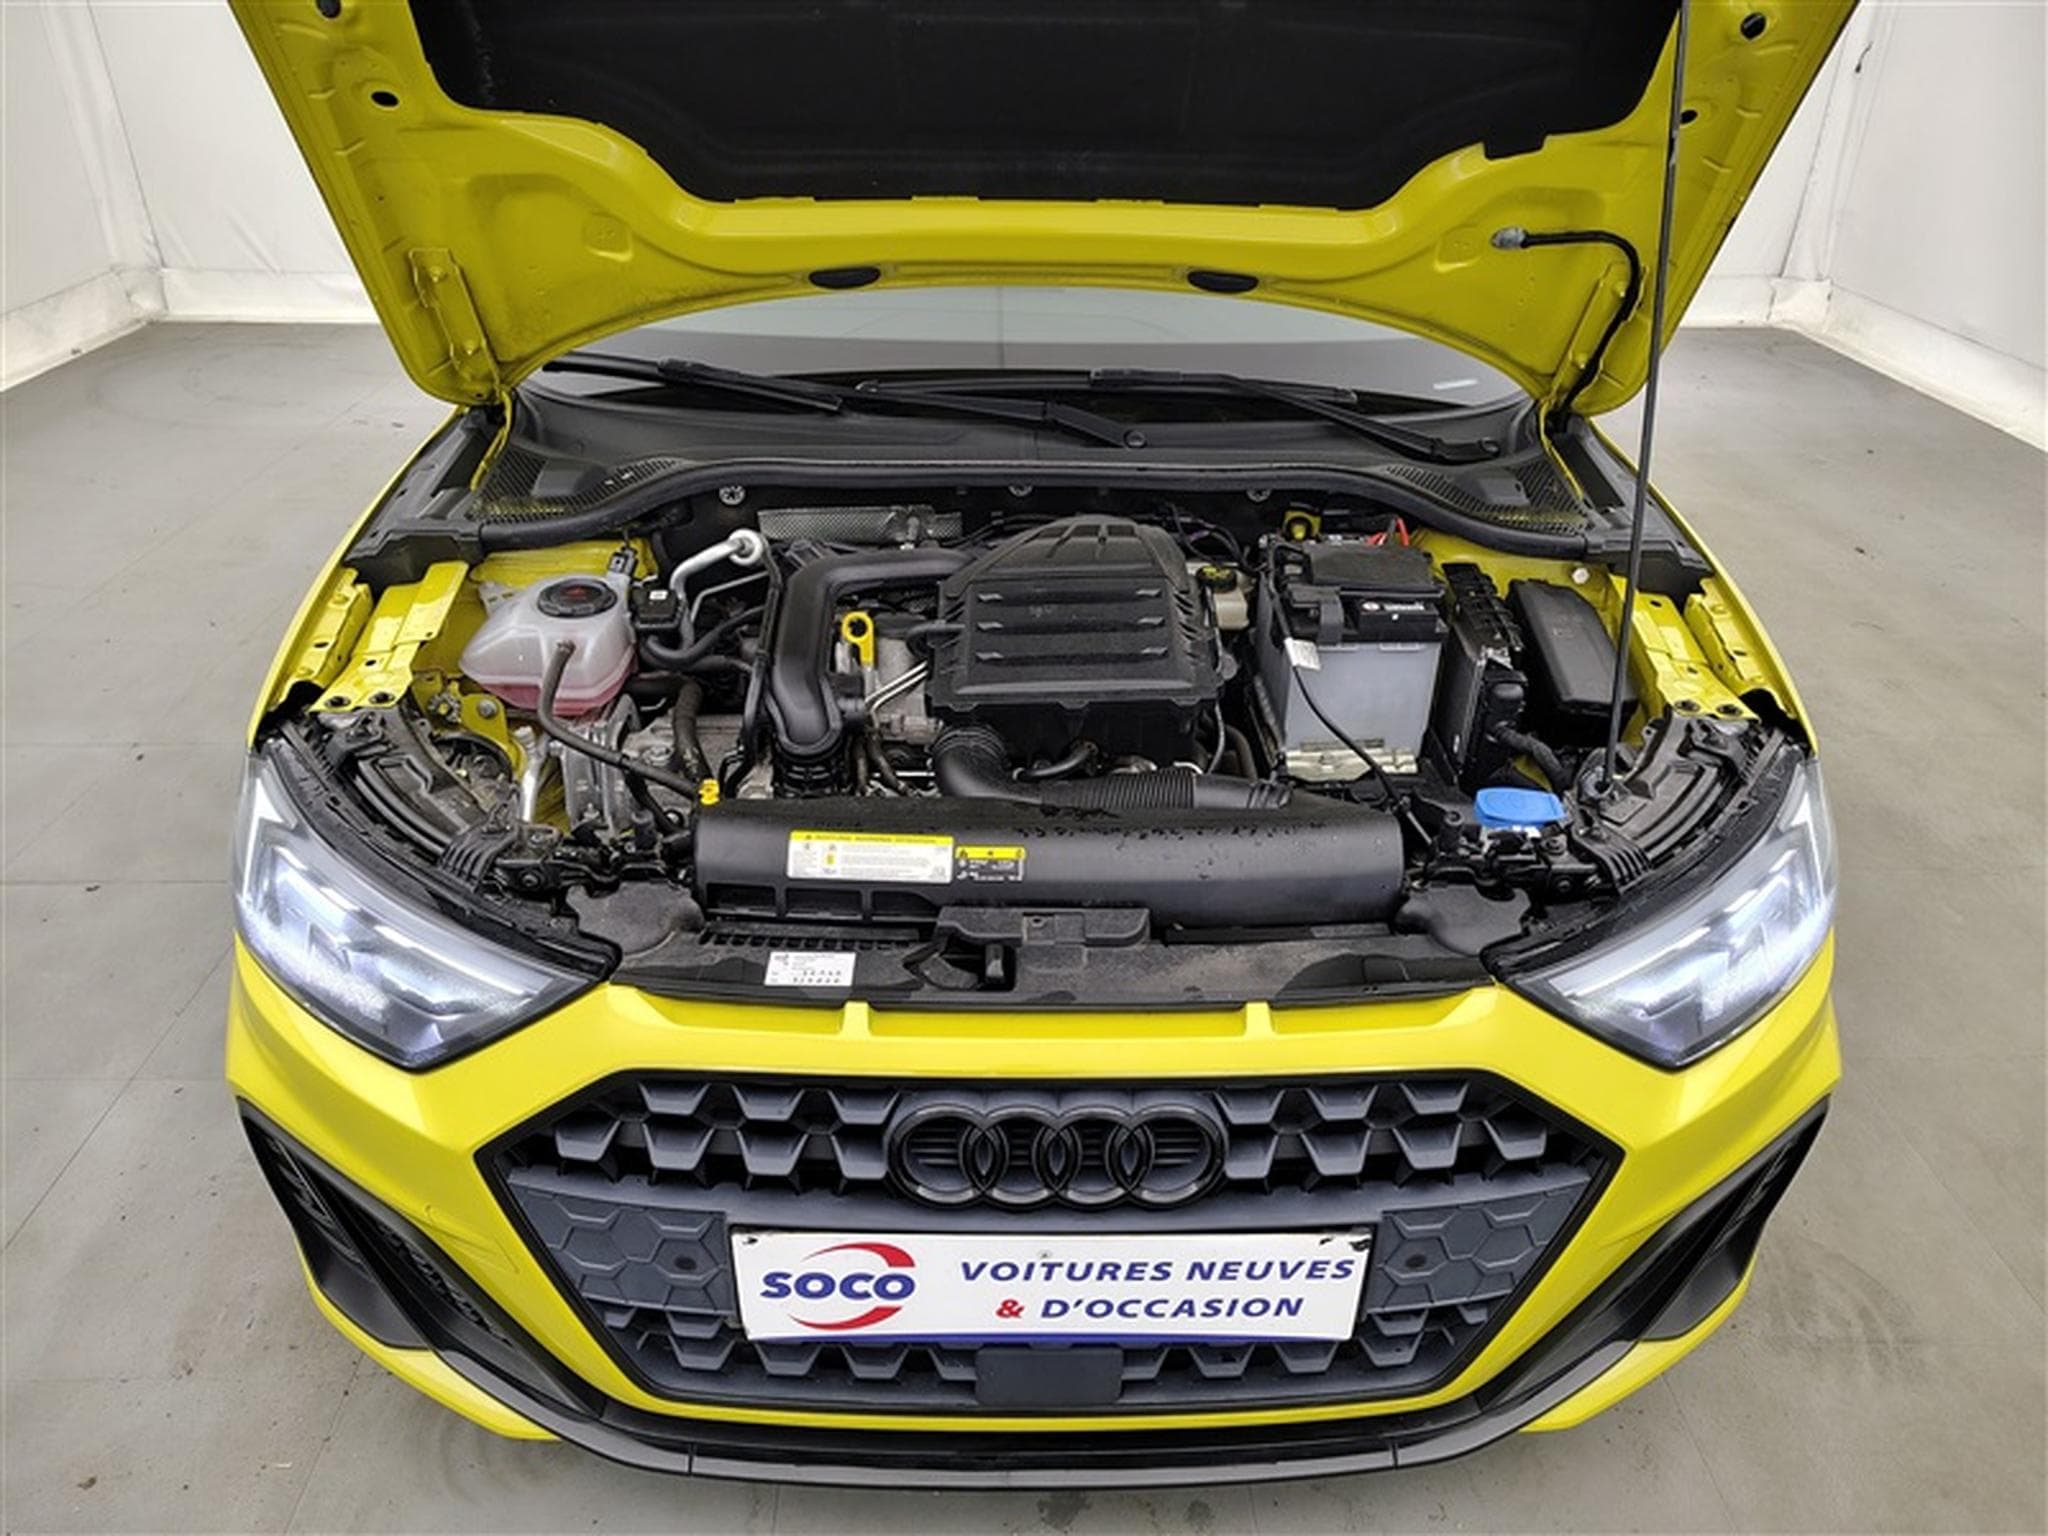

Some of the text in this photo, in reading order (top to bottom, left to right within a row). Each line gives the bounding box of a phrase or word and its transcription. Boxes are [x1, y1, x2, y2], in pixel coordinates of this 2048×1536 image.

[961, 1259, 1355, 1282] VOITURES NEUVES
[761, 1271, 916, 1301] SOCO
[995, 1297, 1305, 1319] & D'OCCASION
